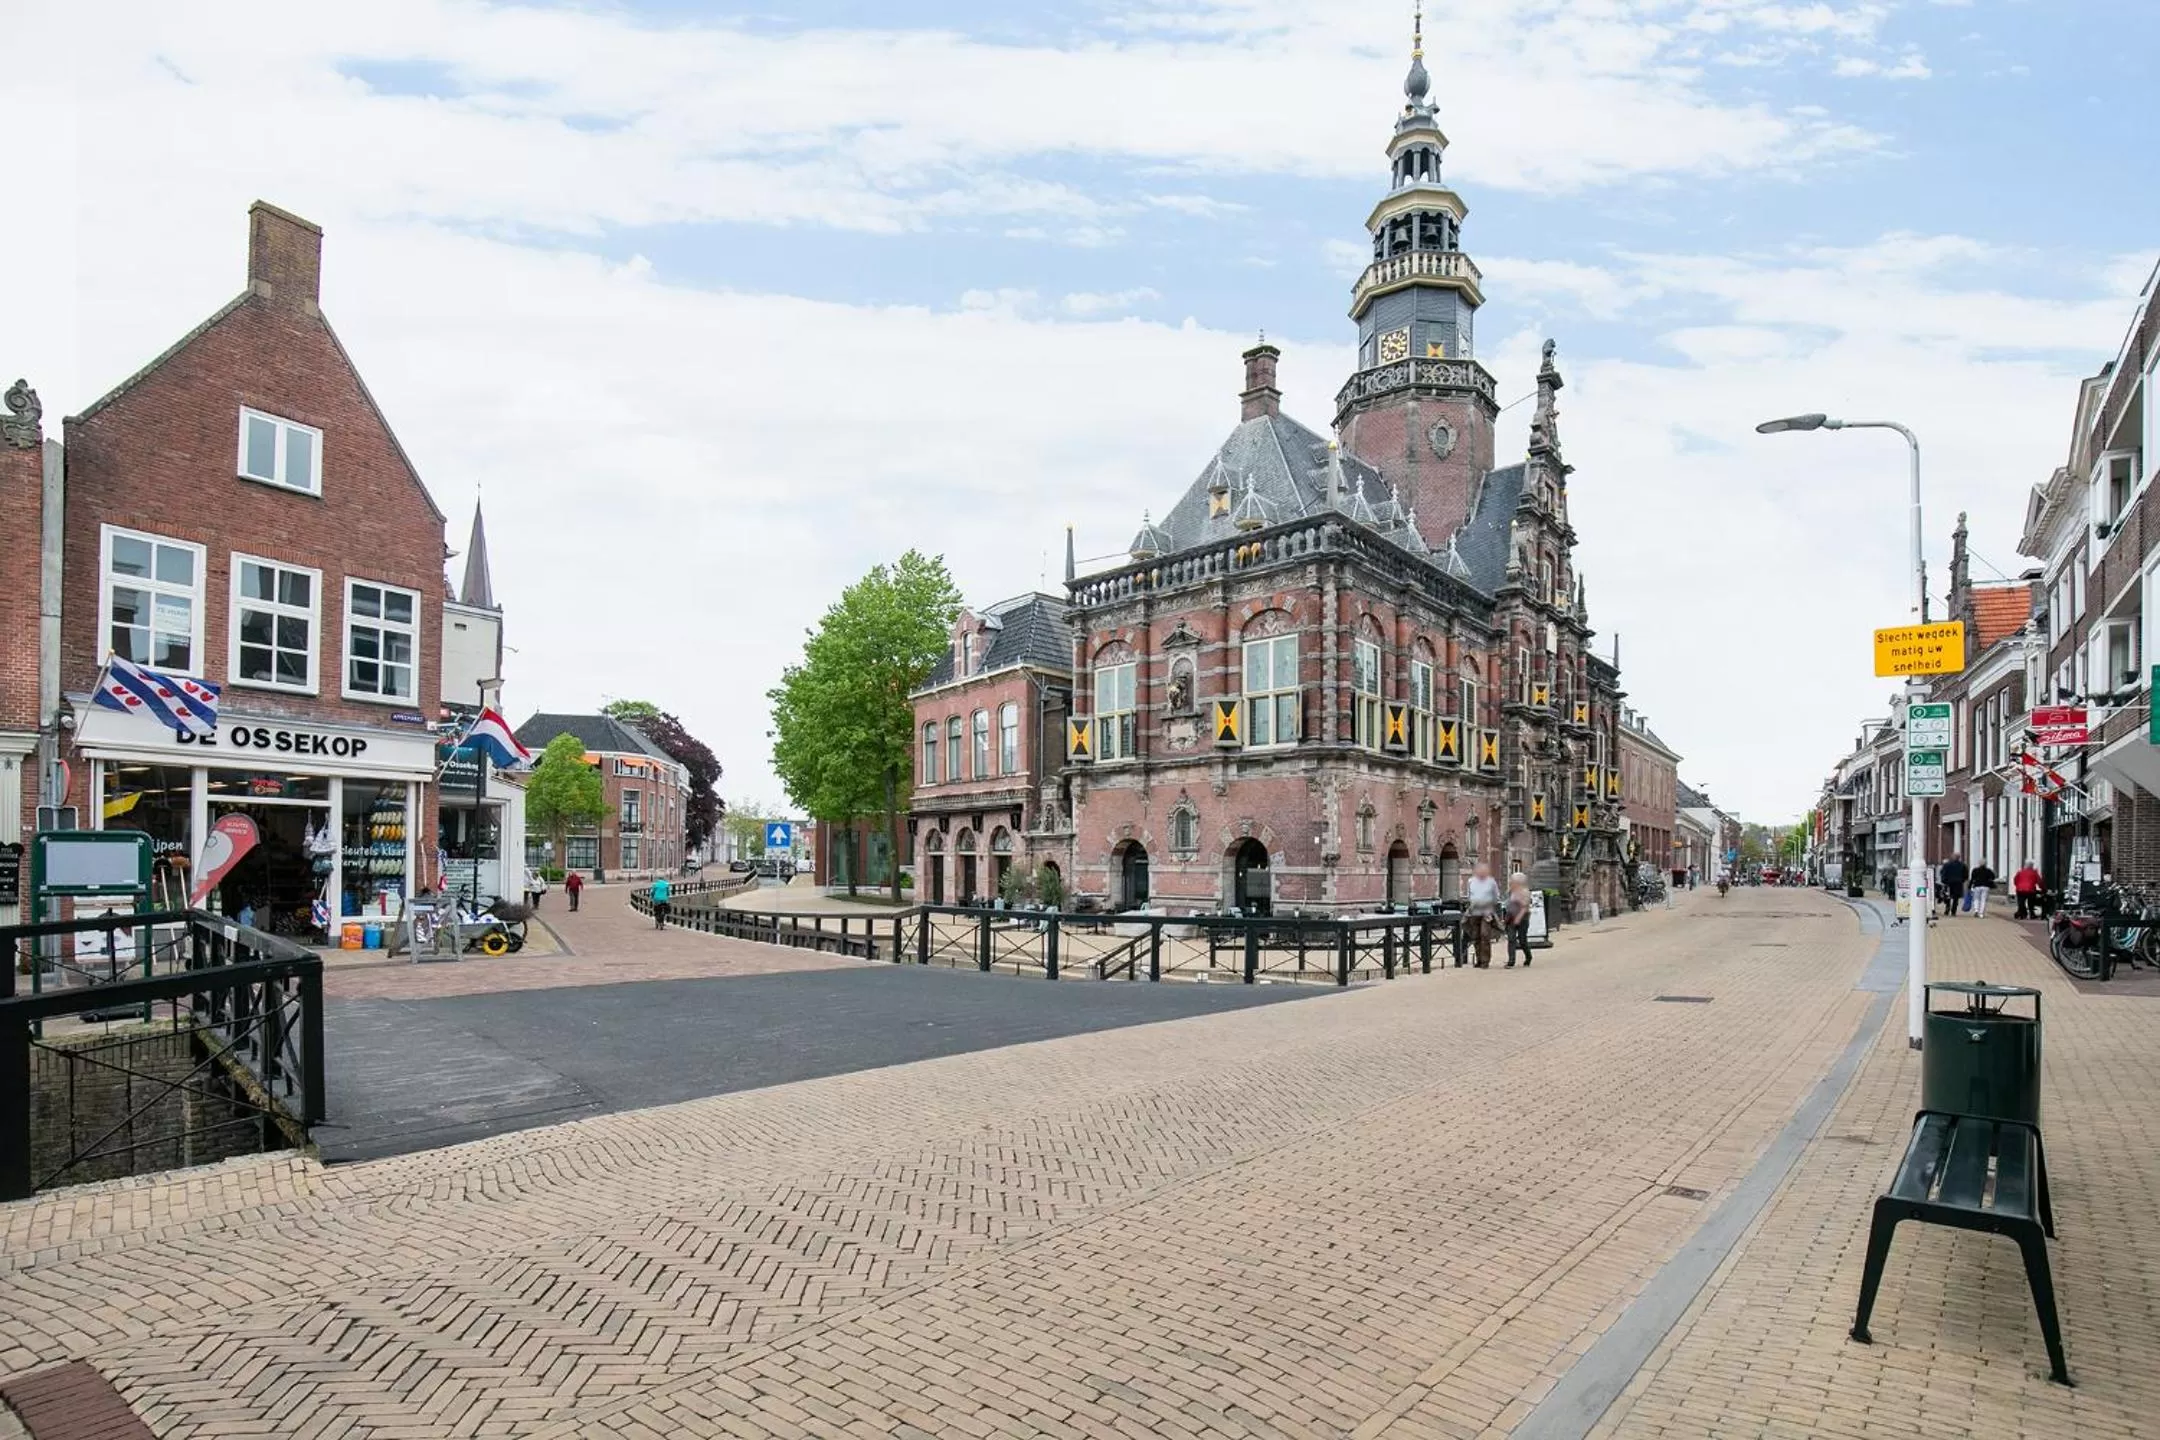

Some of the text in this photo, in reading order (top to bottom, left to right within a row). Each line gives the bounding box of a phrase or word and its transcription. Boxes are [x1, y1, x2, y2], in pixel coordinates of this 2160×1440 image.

[1877, 628, 1958, 643] Slecht wegdek
[1891, 645, 1943, 657] matig uw
[1894, 659, 1942, 671] snelheid
[176, 726, 367, 757] DE OSSEKOP
